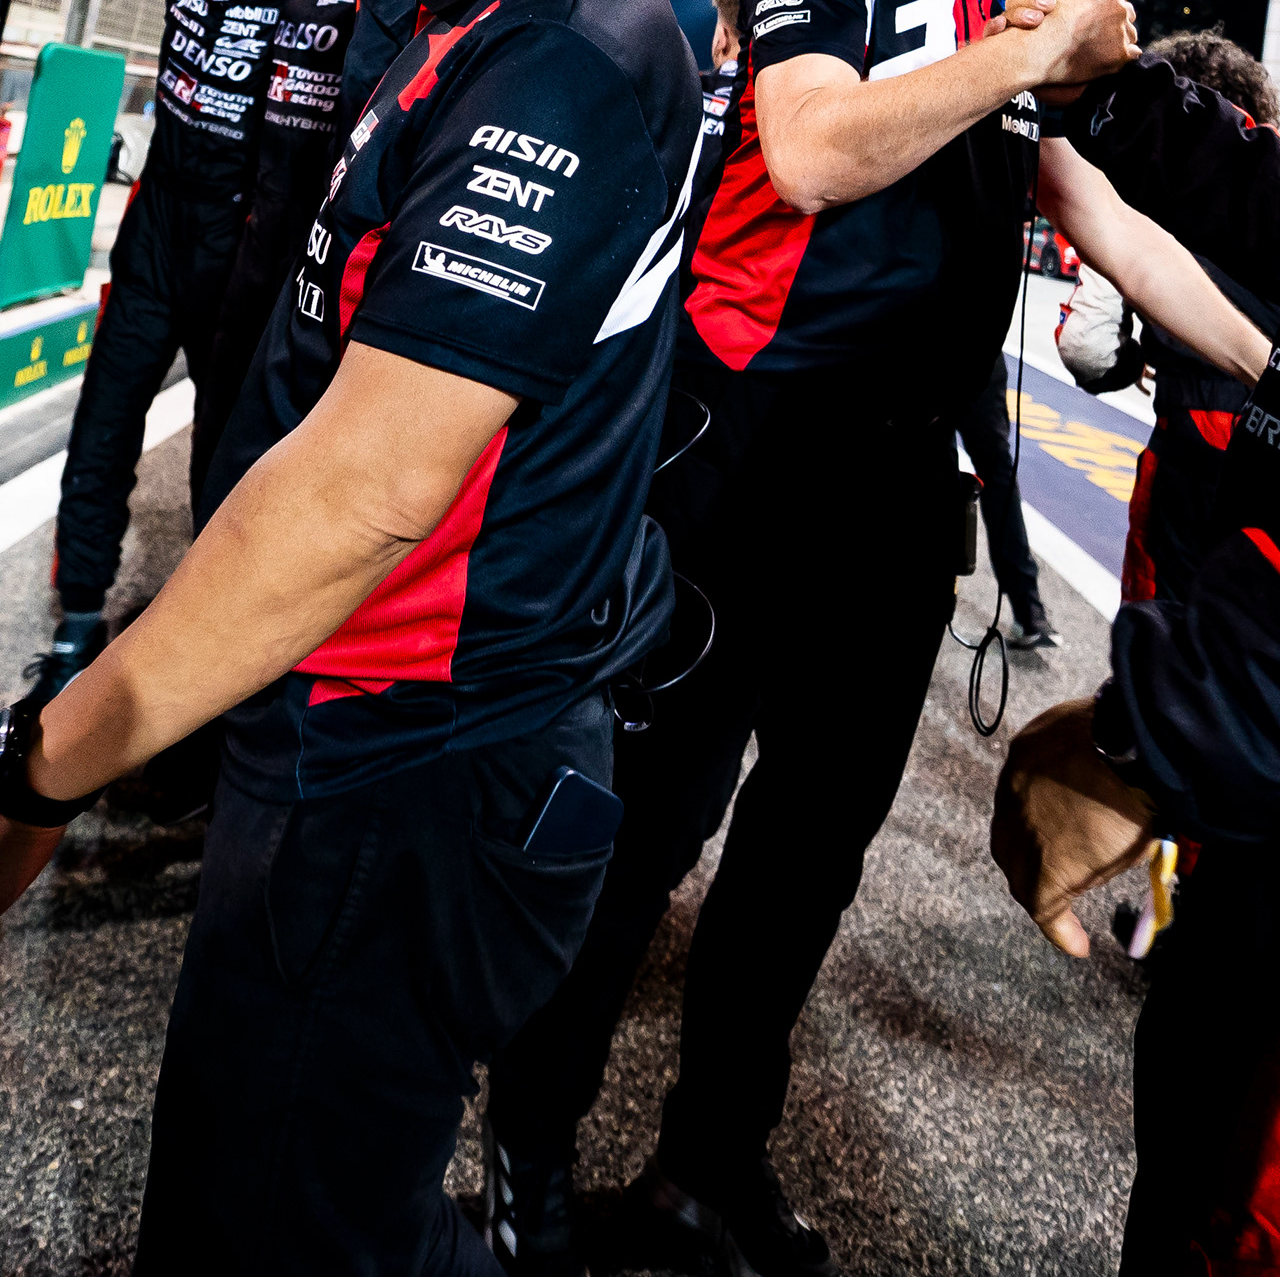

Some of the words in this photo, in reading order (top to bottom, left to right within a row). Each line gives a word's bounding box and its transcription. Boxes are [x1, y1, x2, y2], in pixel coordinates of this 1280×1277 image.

[220, 19, 260, 38] ZENT
[170, 29, 252, 82] DENSO
[1002, 113, 1029, 138] Mobil
[468, 125, 580, 178] AISIN
[23, 182, 96, 225] ROLEX
[466, 165, 555, 212] ZENT
[439, 204, 553, 256] RAYS
[446, 259, 531, 298] MICHELIN
